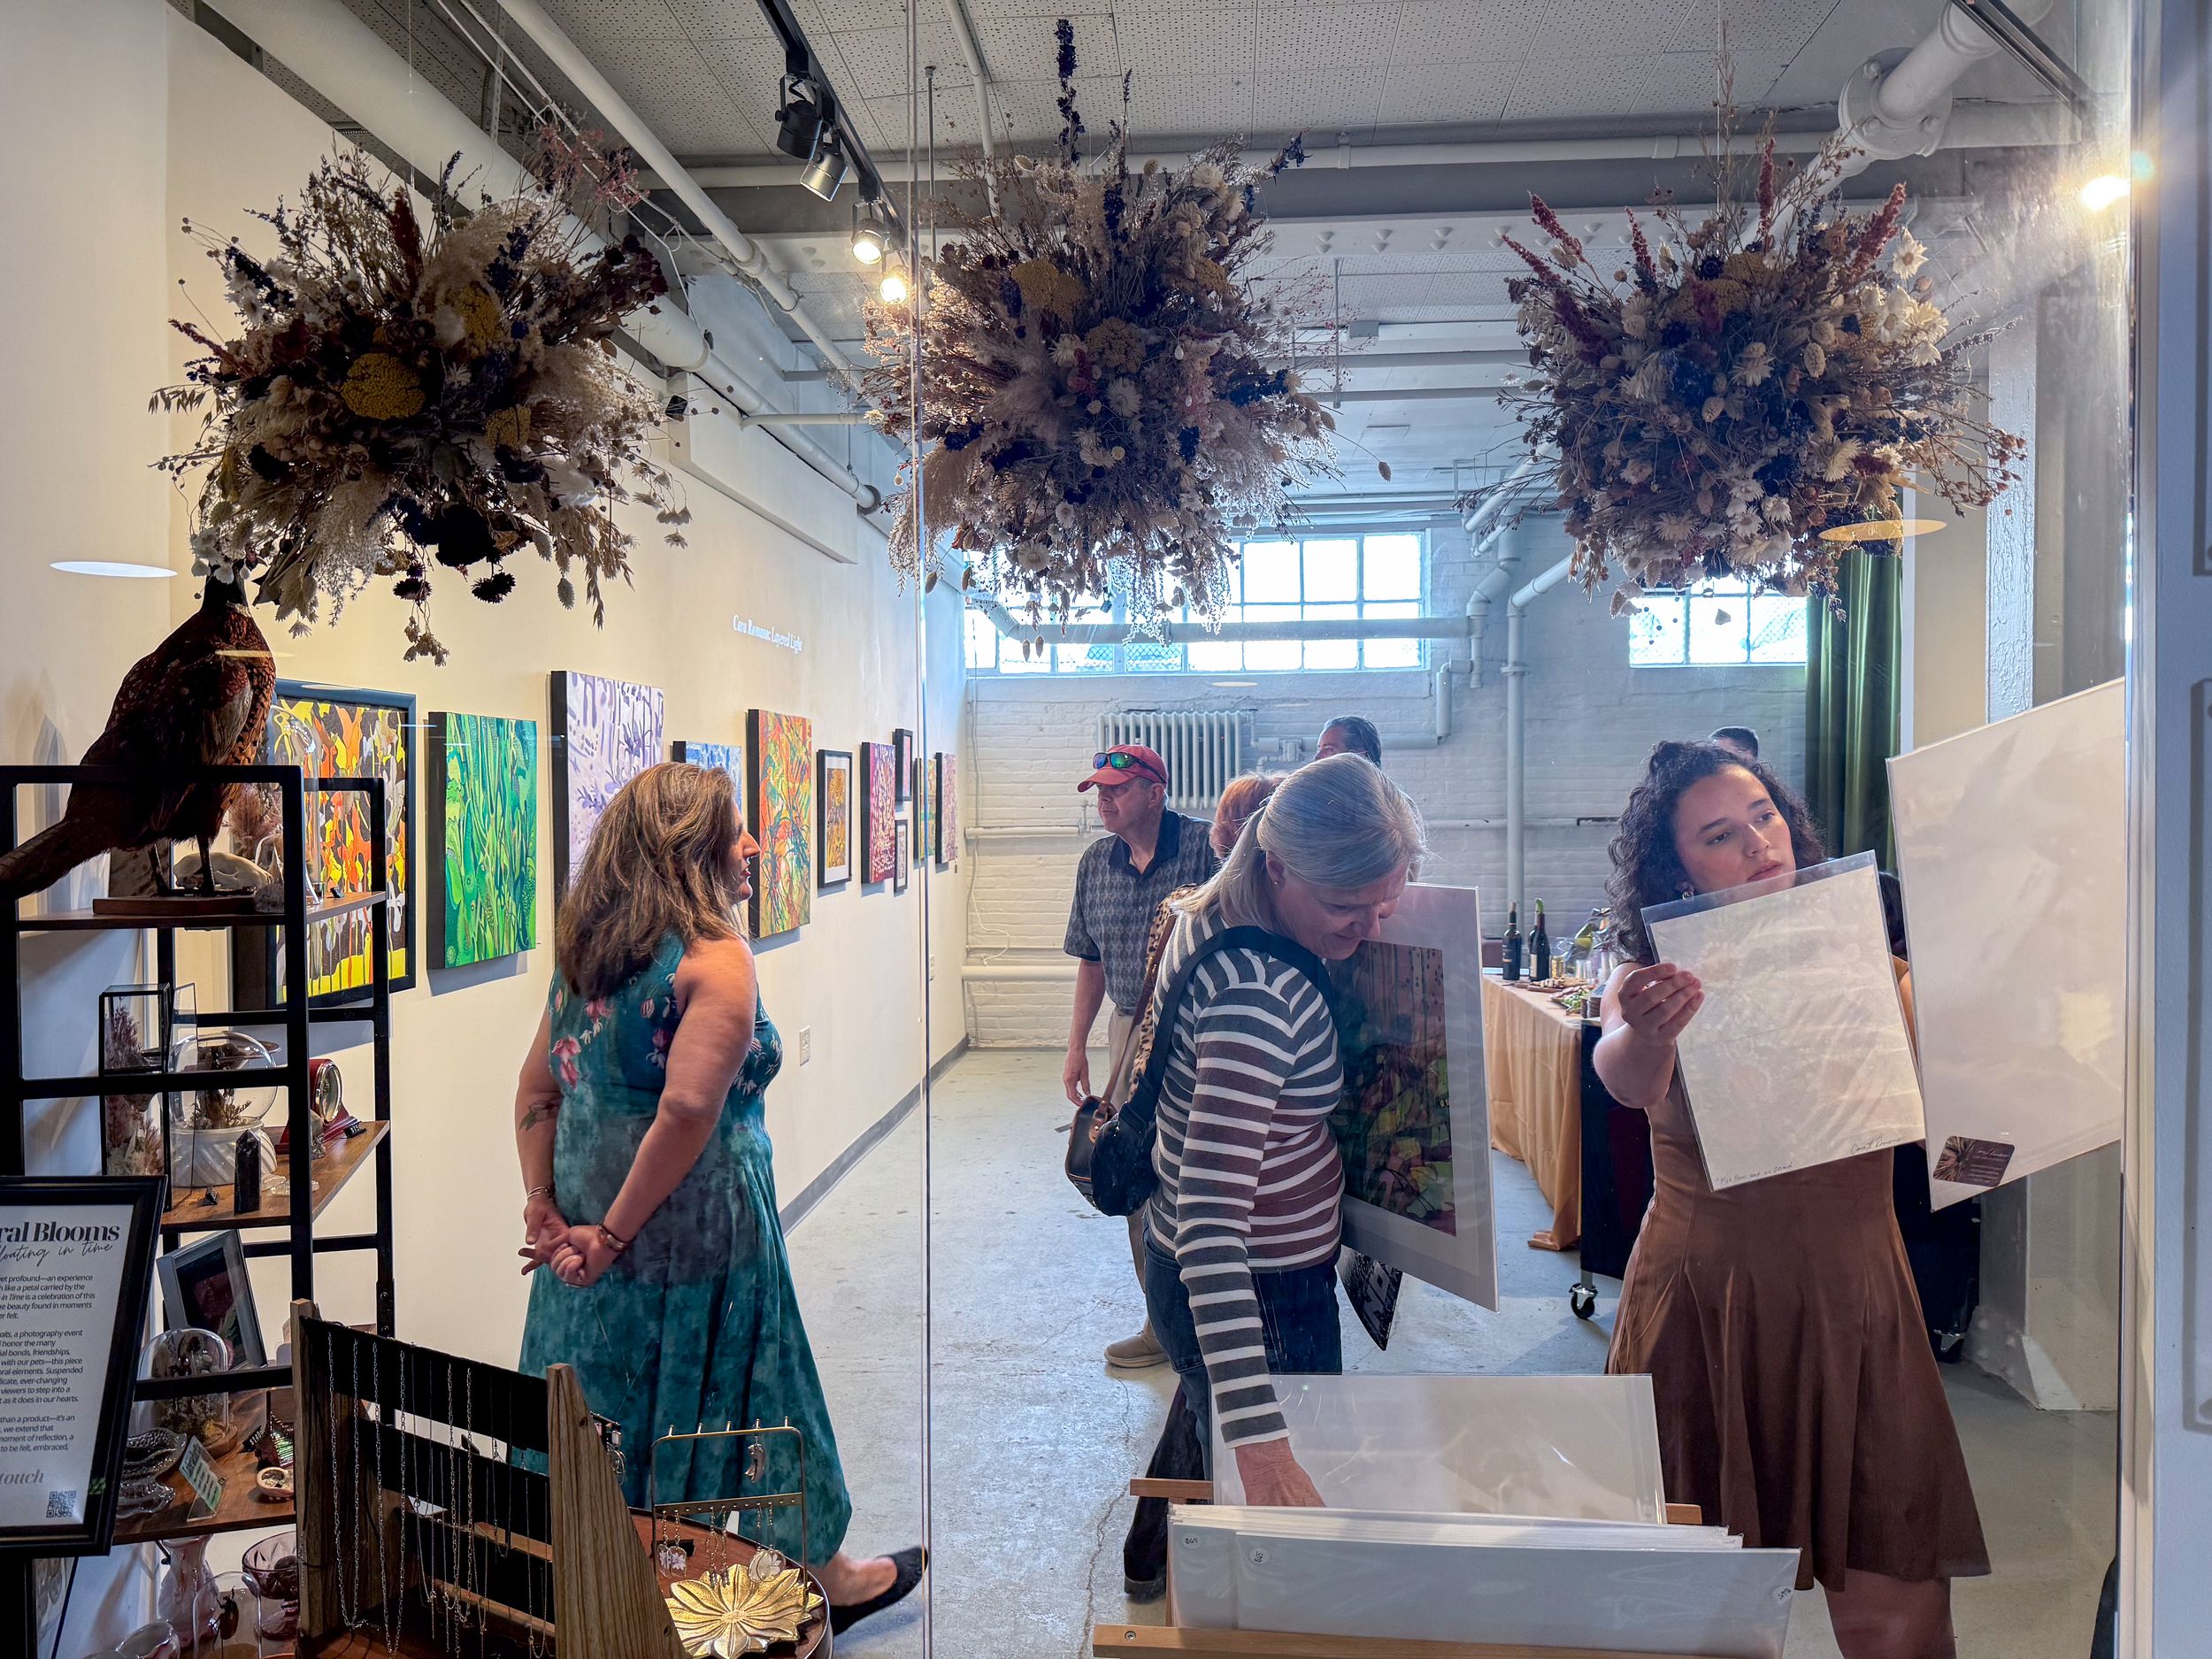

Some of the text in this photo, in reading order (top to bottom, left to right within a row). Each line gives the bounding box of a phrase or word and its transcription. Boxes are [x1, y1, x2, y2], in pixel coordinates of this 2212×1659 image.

[33, 1221, 120, 1241] Blooms
[58, 1246, 74, 1256] in
[81, 1241, 112, 1256] time
[19, 1330, 64, 1339] photography
[45, 1366, 83, 1375] Suspended
